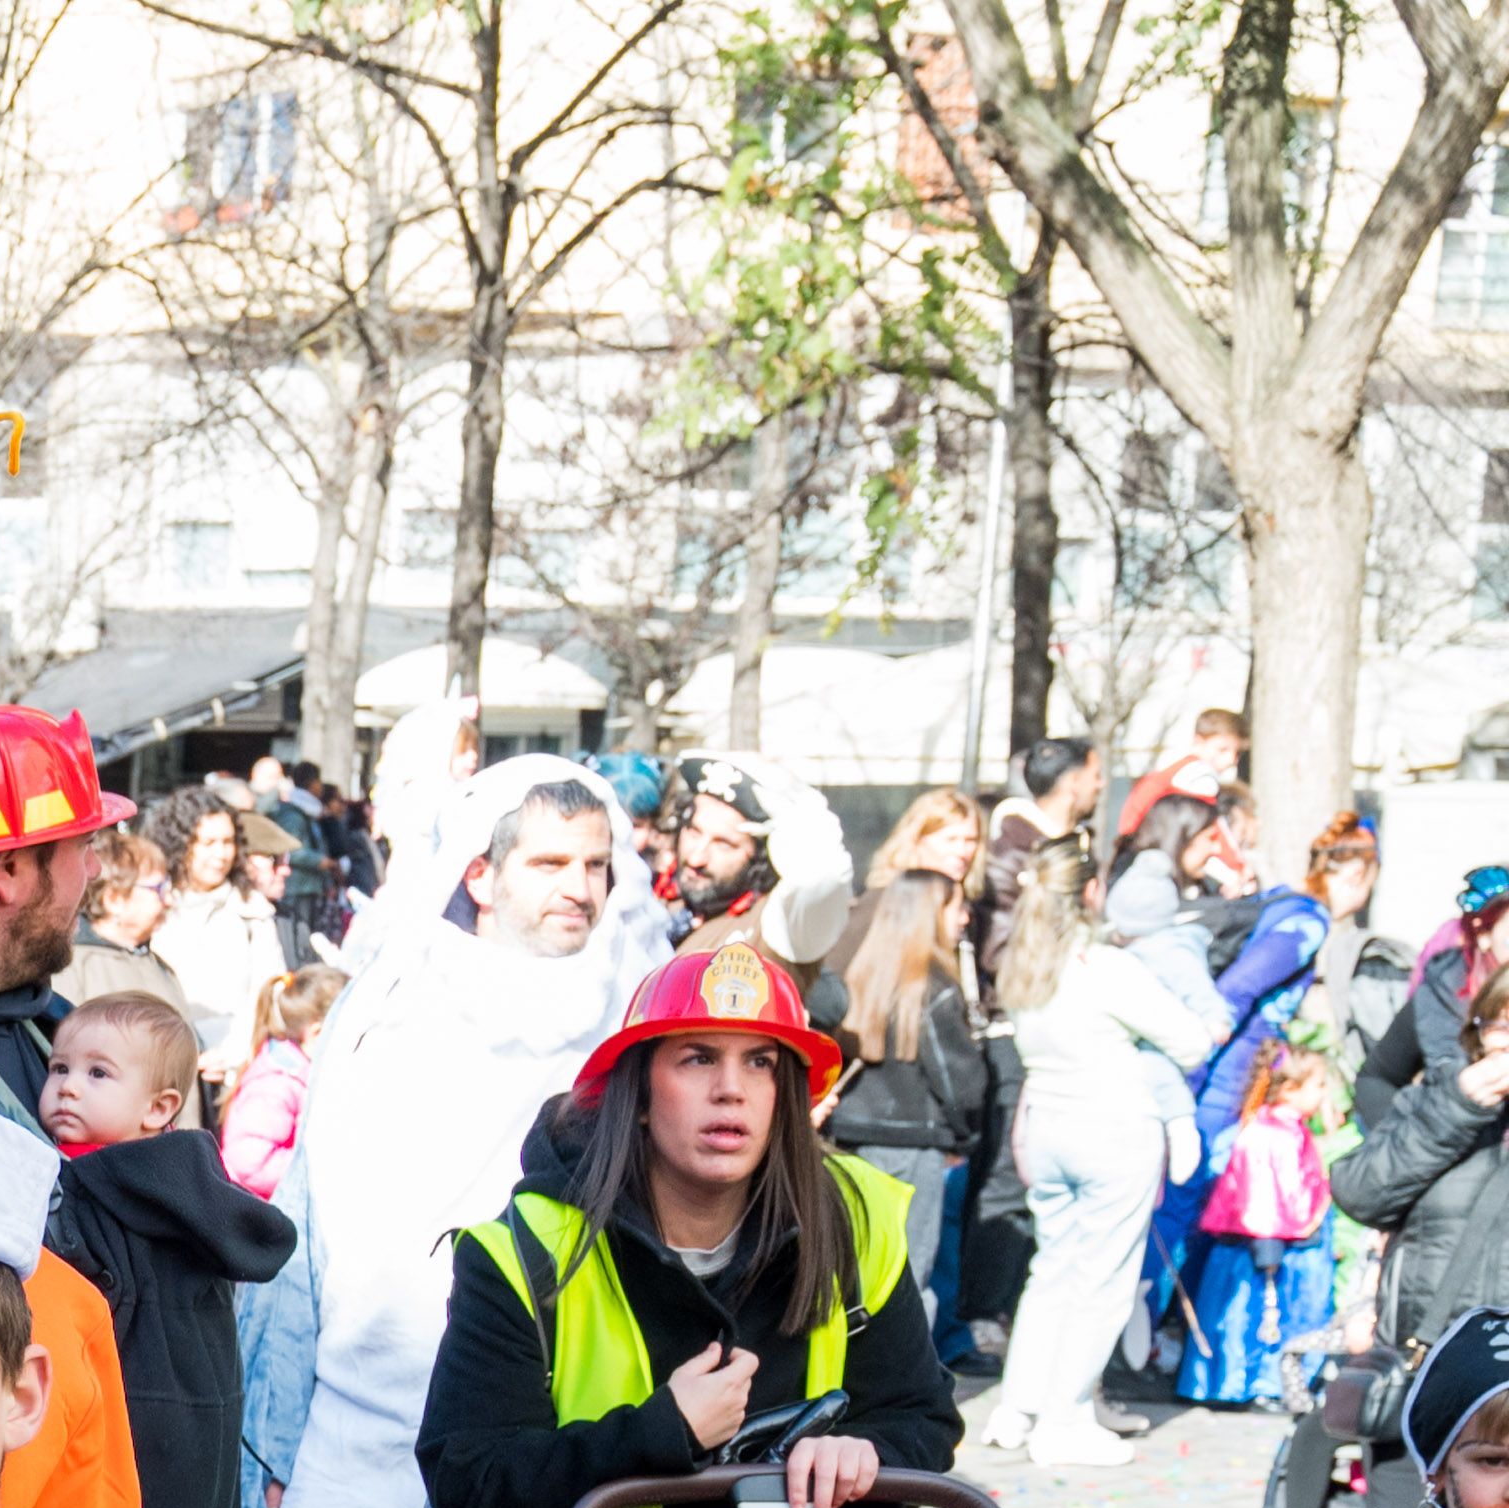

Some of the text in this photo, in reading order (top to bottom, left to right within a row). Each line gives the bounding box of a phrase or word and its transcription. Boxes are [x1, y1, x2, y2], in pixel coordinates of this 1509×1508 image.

[720, 951, 755, 964] FIRE
[712, 965, 760, 980] CHIEF
[729, 992, 738, 1009] 1
